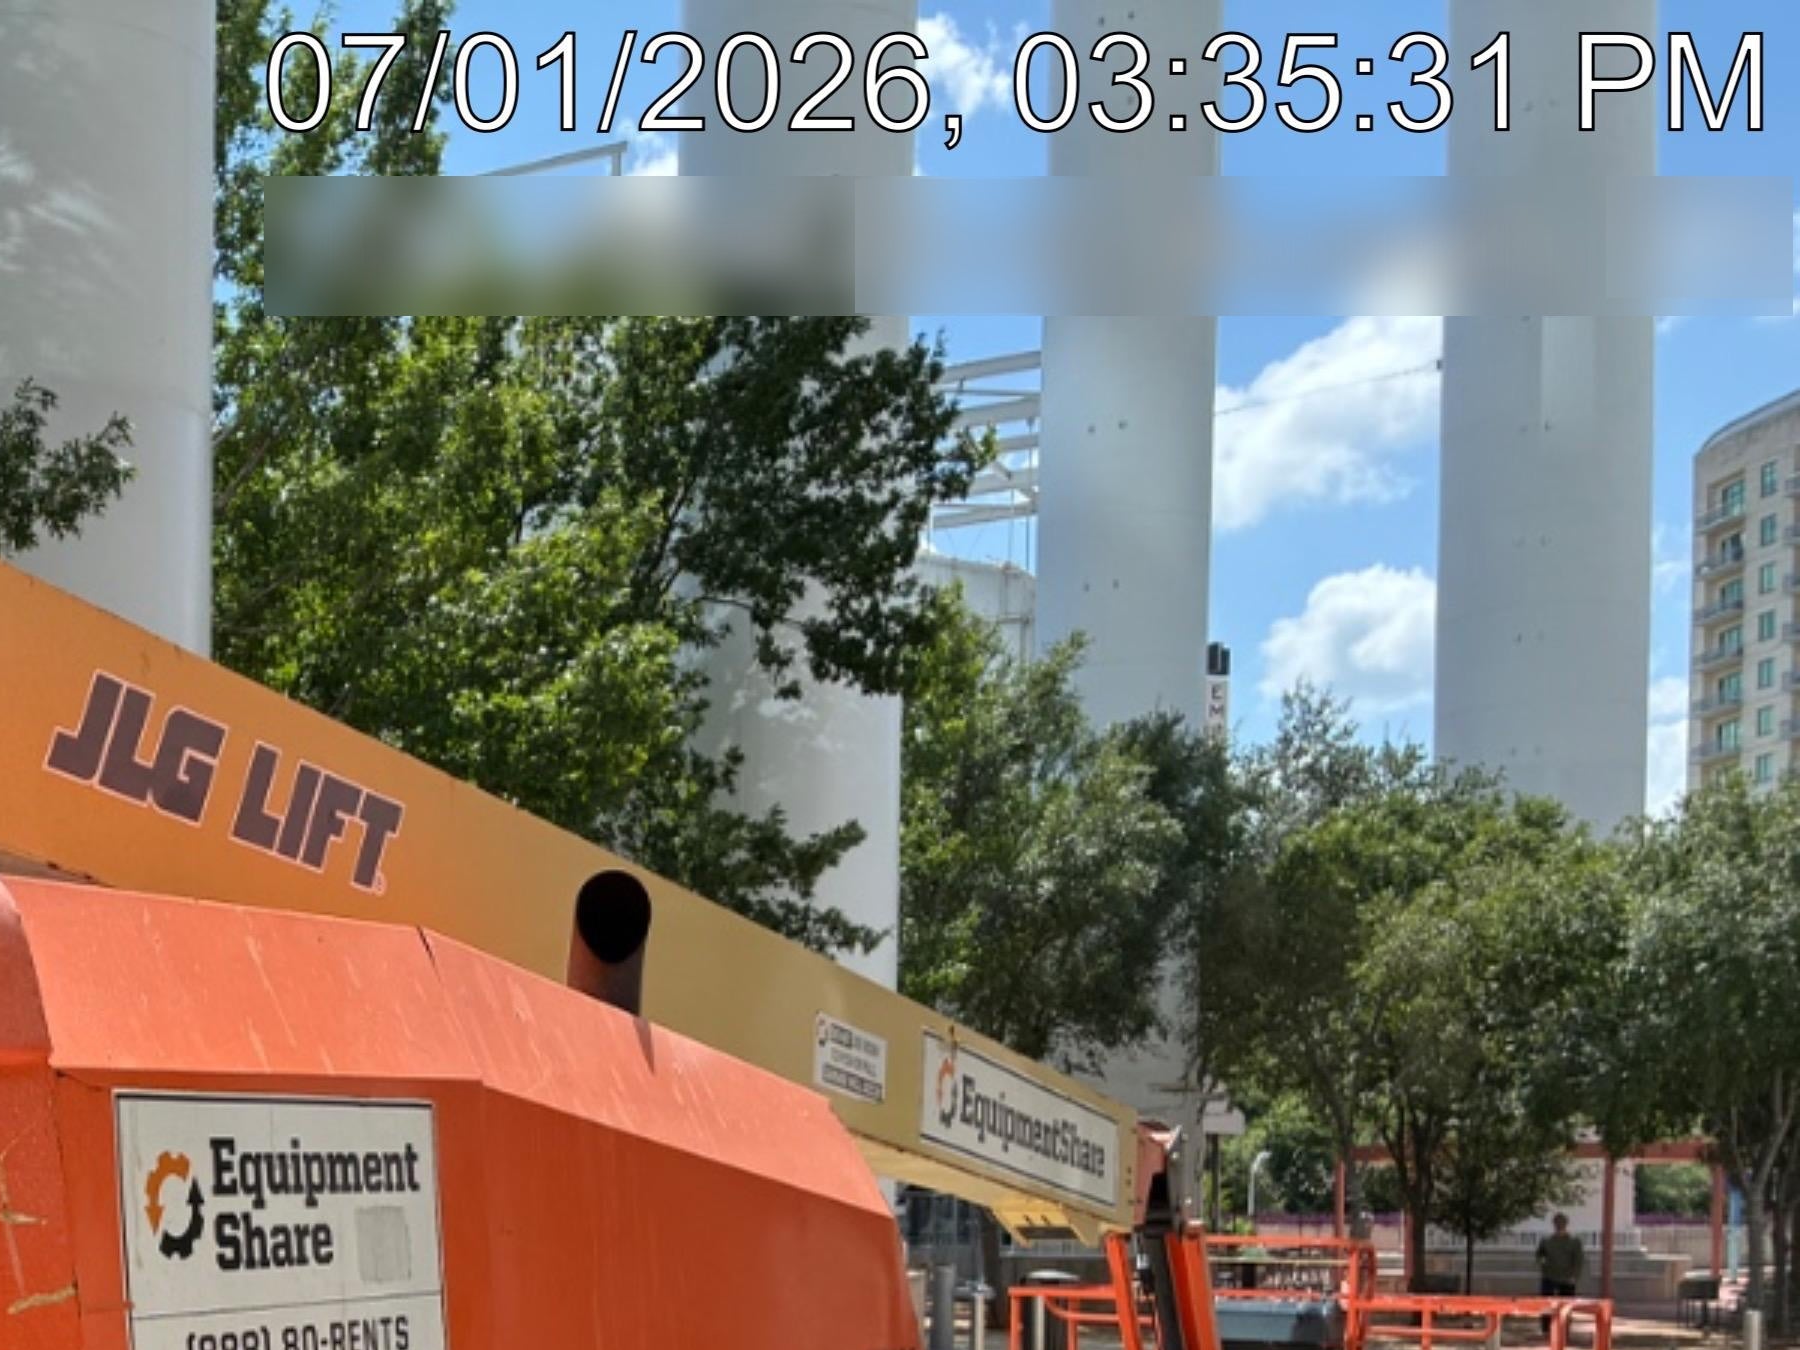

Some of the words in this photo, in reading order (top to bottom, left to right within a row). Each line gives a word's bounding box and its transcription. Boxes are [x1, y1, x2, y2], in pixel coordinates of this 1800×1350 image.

[43, 669, 228, 828] JLG
[229, 740, 405, 893] LIFT
[960, 1073, 1105, 1178] EquipmentShare
[209, 1137, 420, 1208] Equipment
[214, 1212, 334, 1271] Share
